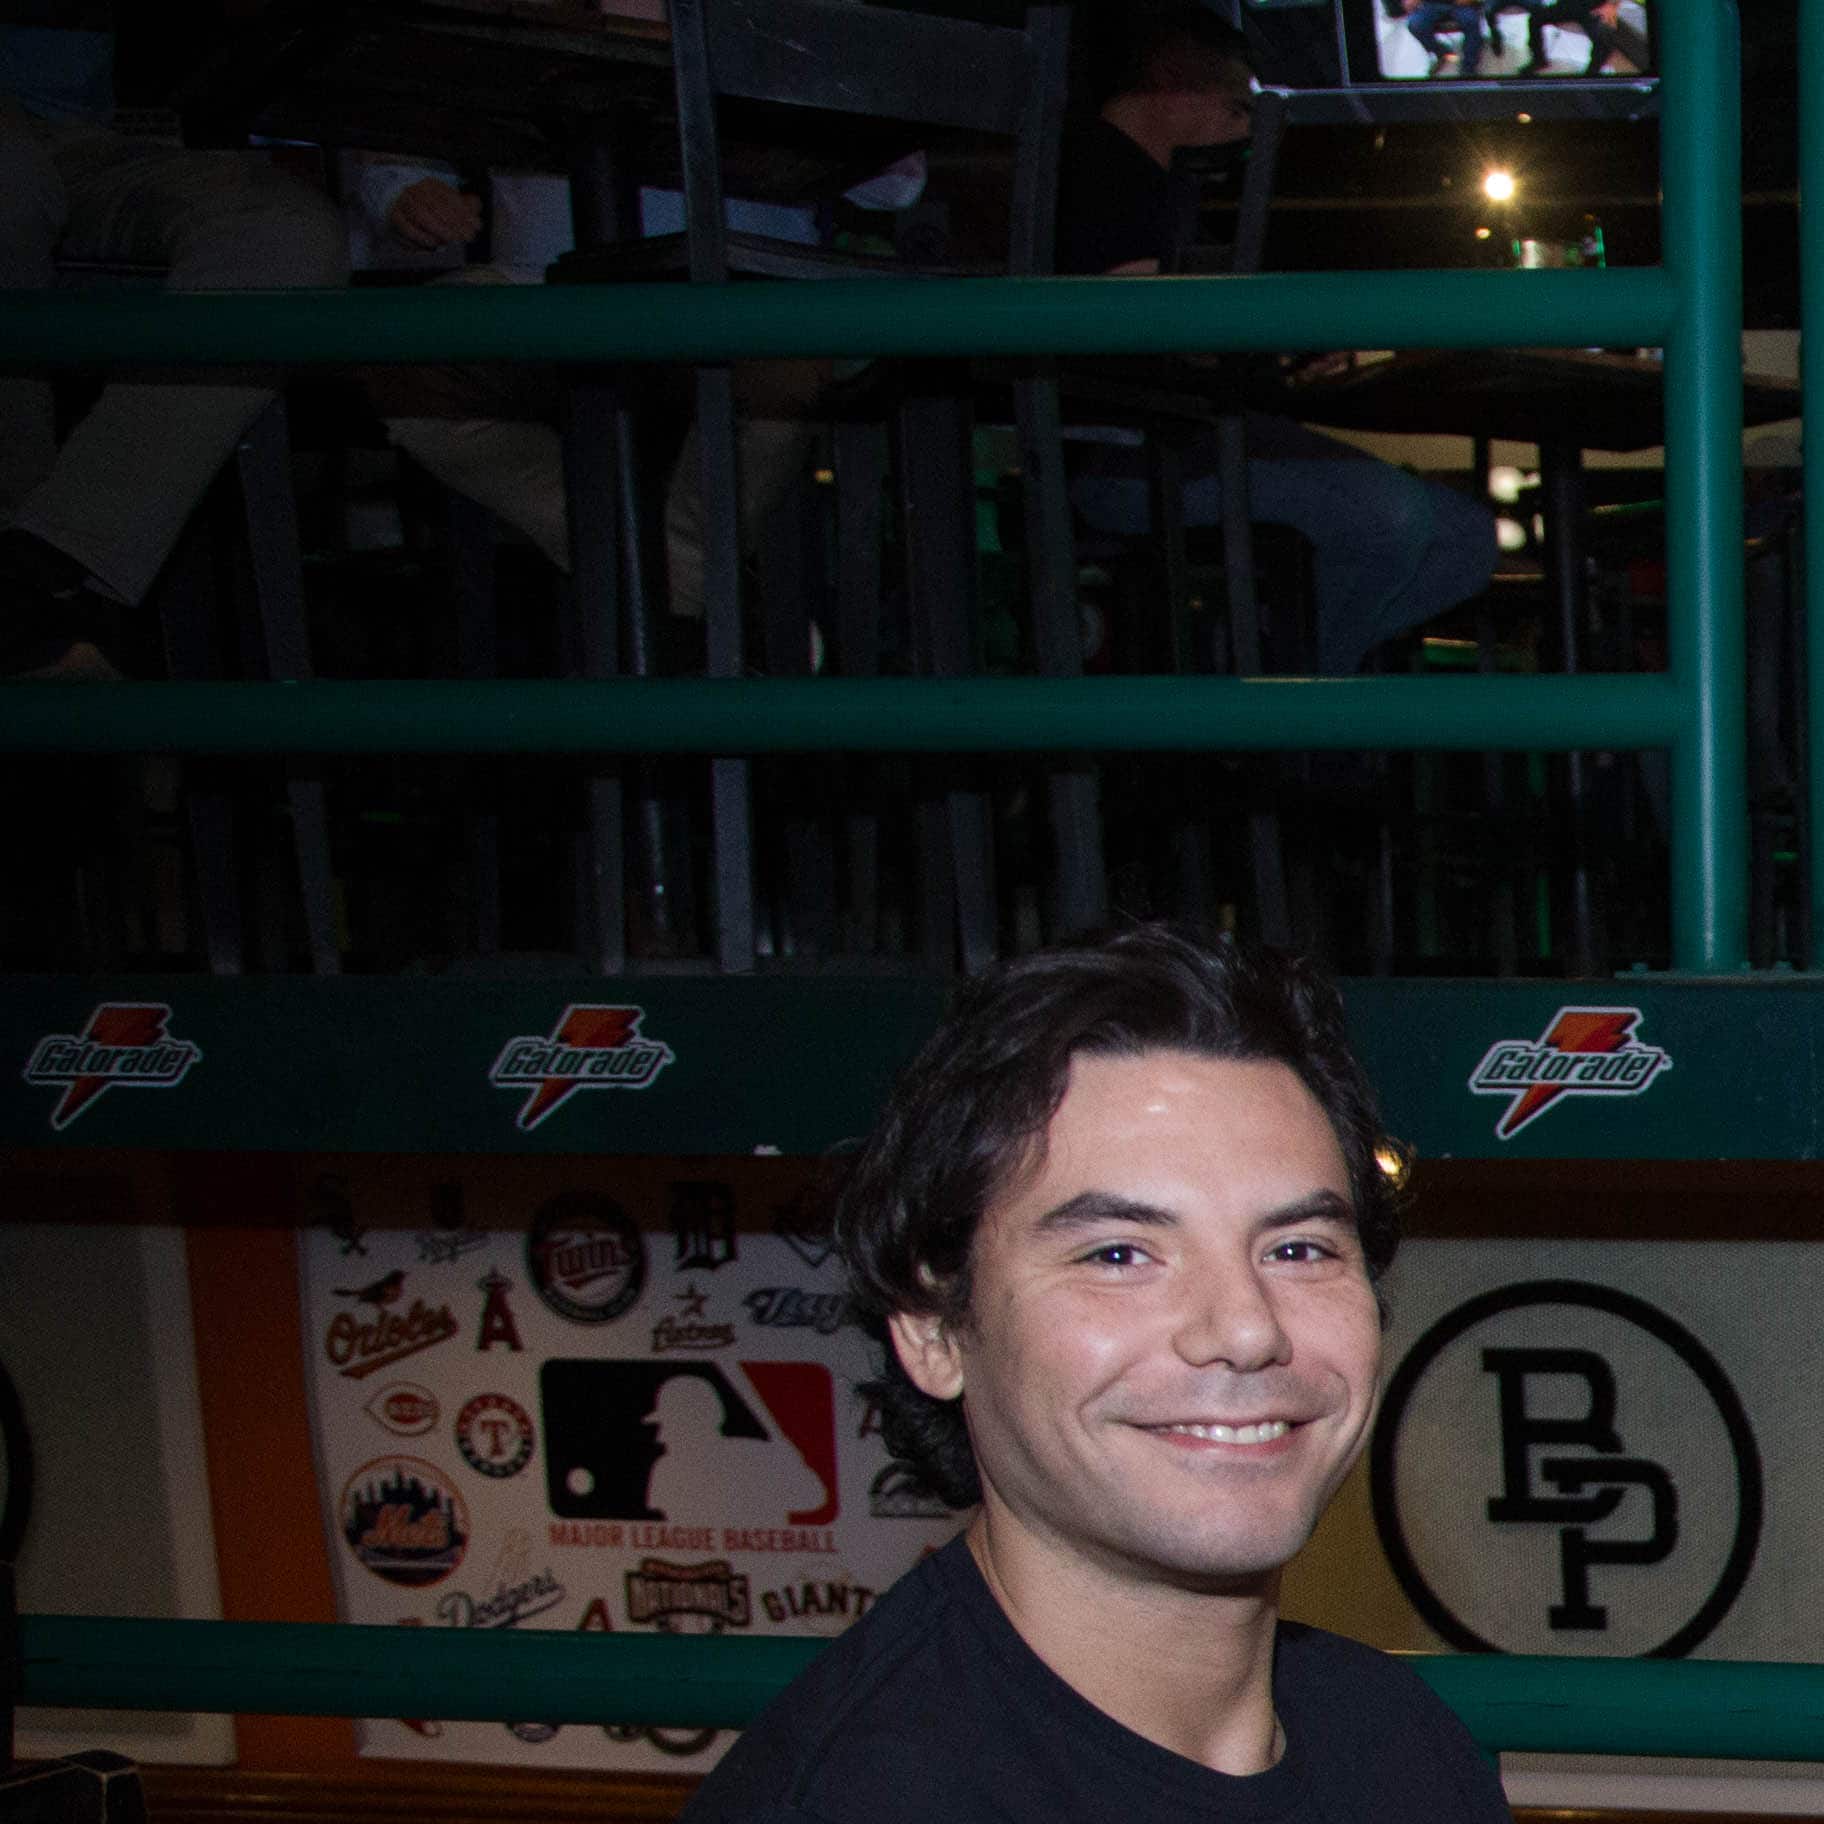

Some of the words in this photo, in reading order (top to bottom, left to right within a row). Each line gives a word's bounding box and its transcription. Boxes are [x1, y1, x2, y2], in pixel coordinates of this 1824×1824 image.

[38, 1042, 190, 1078] Gatorade
[503, 1042, 663, 1079] Gatorade
[1481, 1049, 1660, 1085] Gatorade
[550, 1523, 623, 1547] MAJOR
[631, 1525, 715, 1550] LEAGUE
[723, 1527, 838, 1552] BASEBALL
[762, 1582, 876, 1622] GIANT
